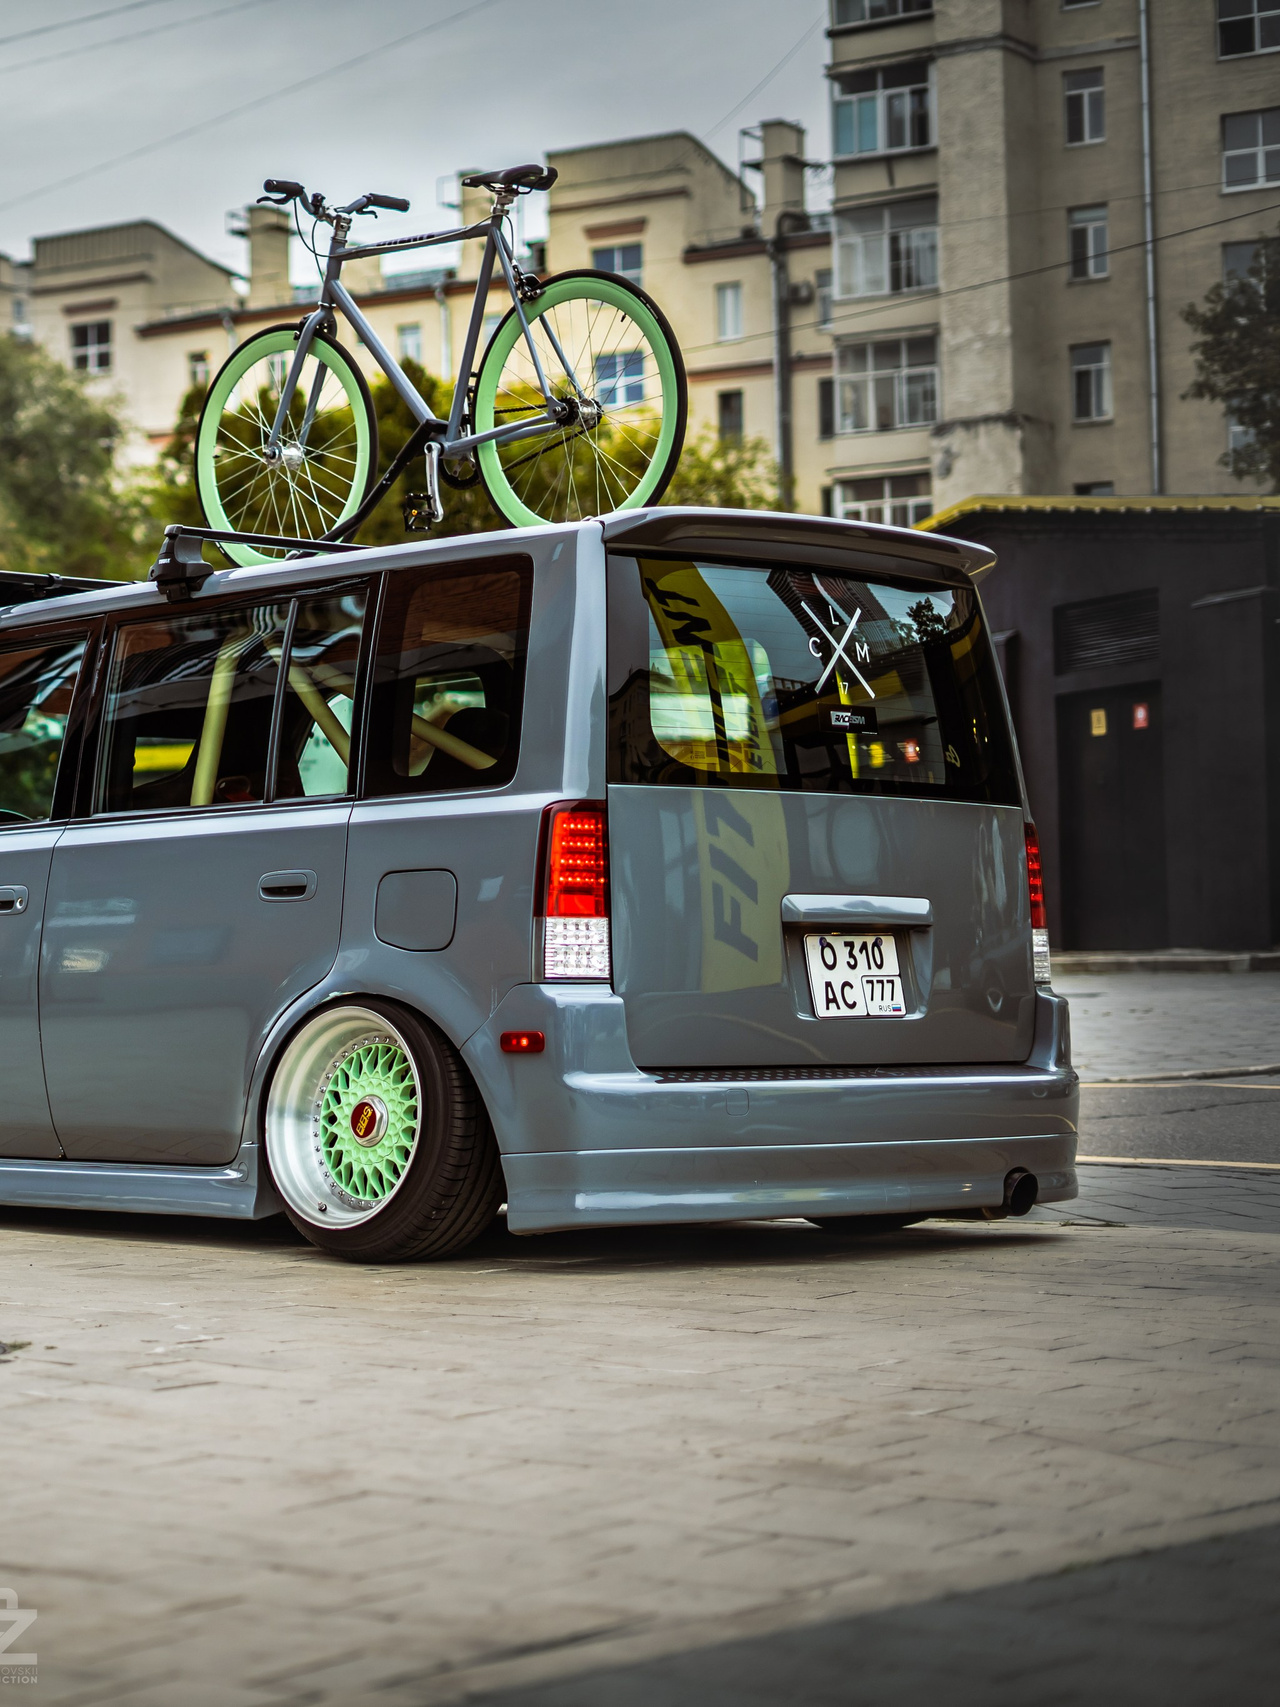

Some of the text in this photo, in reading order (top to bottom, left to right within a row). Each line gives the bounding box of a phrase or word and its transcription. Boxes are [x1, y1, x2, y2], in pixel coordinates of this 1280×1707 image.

[842, 940, 884, 970] 310
[866, 980, 895, 1002] 777
[878, 1004, 892, 1012] RUS
[356, 1105, 373, 1136] BBS
